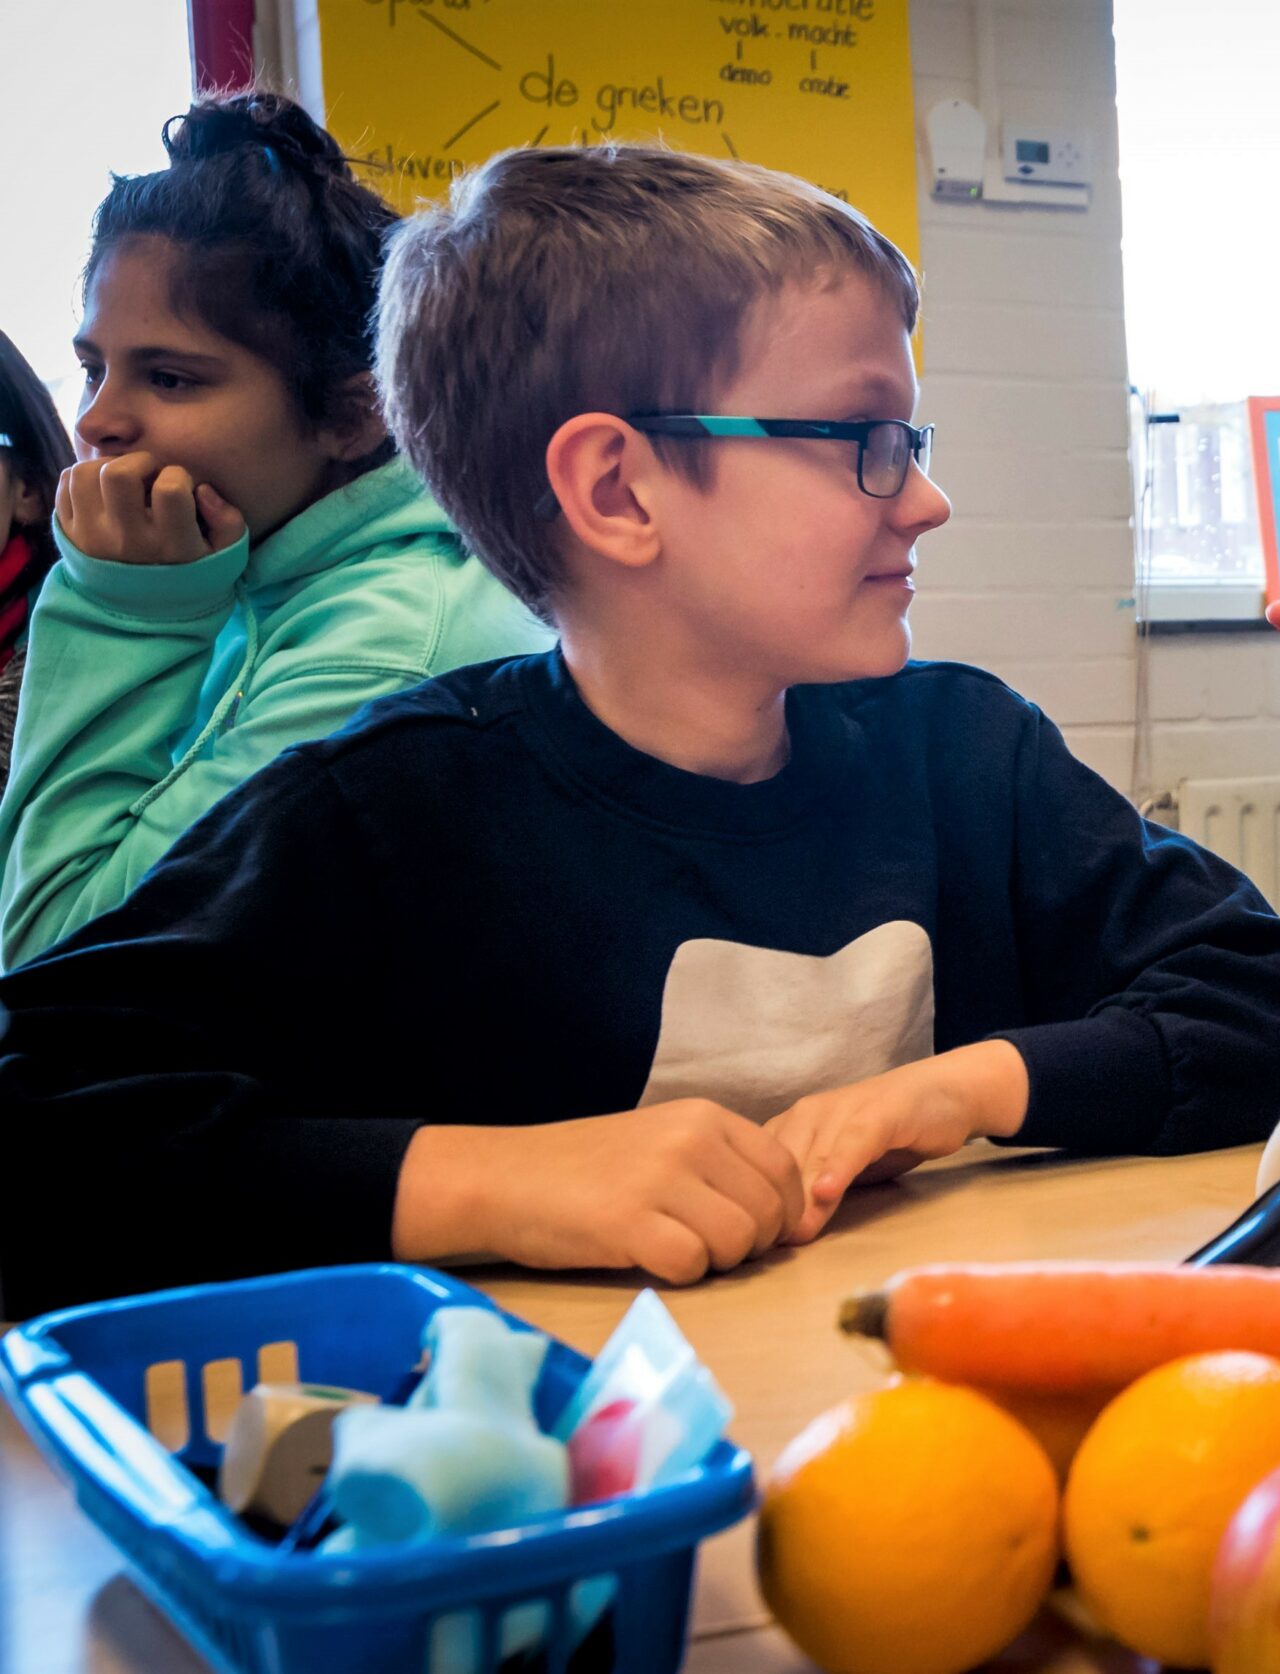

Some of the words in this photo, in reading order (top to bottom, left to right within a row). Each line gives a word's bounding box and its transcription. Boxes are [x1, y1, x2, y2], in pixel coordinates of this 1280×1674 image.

[719, 14, 769, 37] volk
[788, 20, 857, 47] macht
[519, 53, 579, 107] de
[590, 76, 724, 133] grieken
